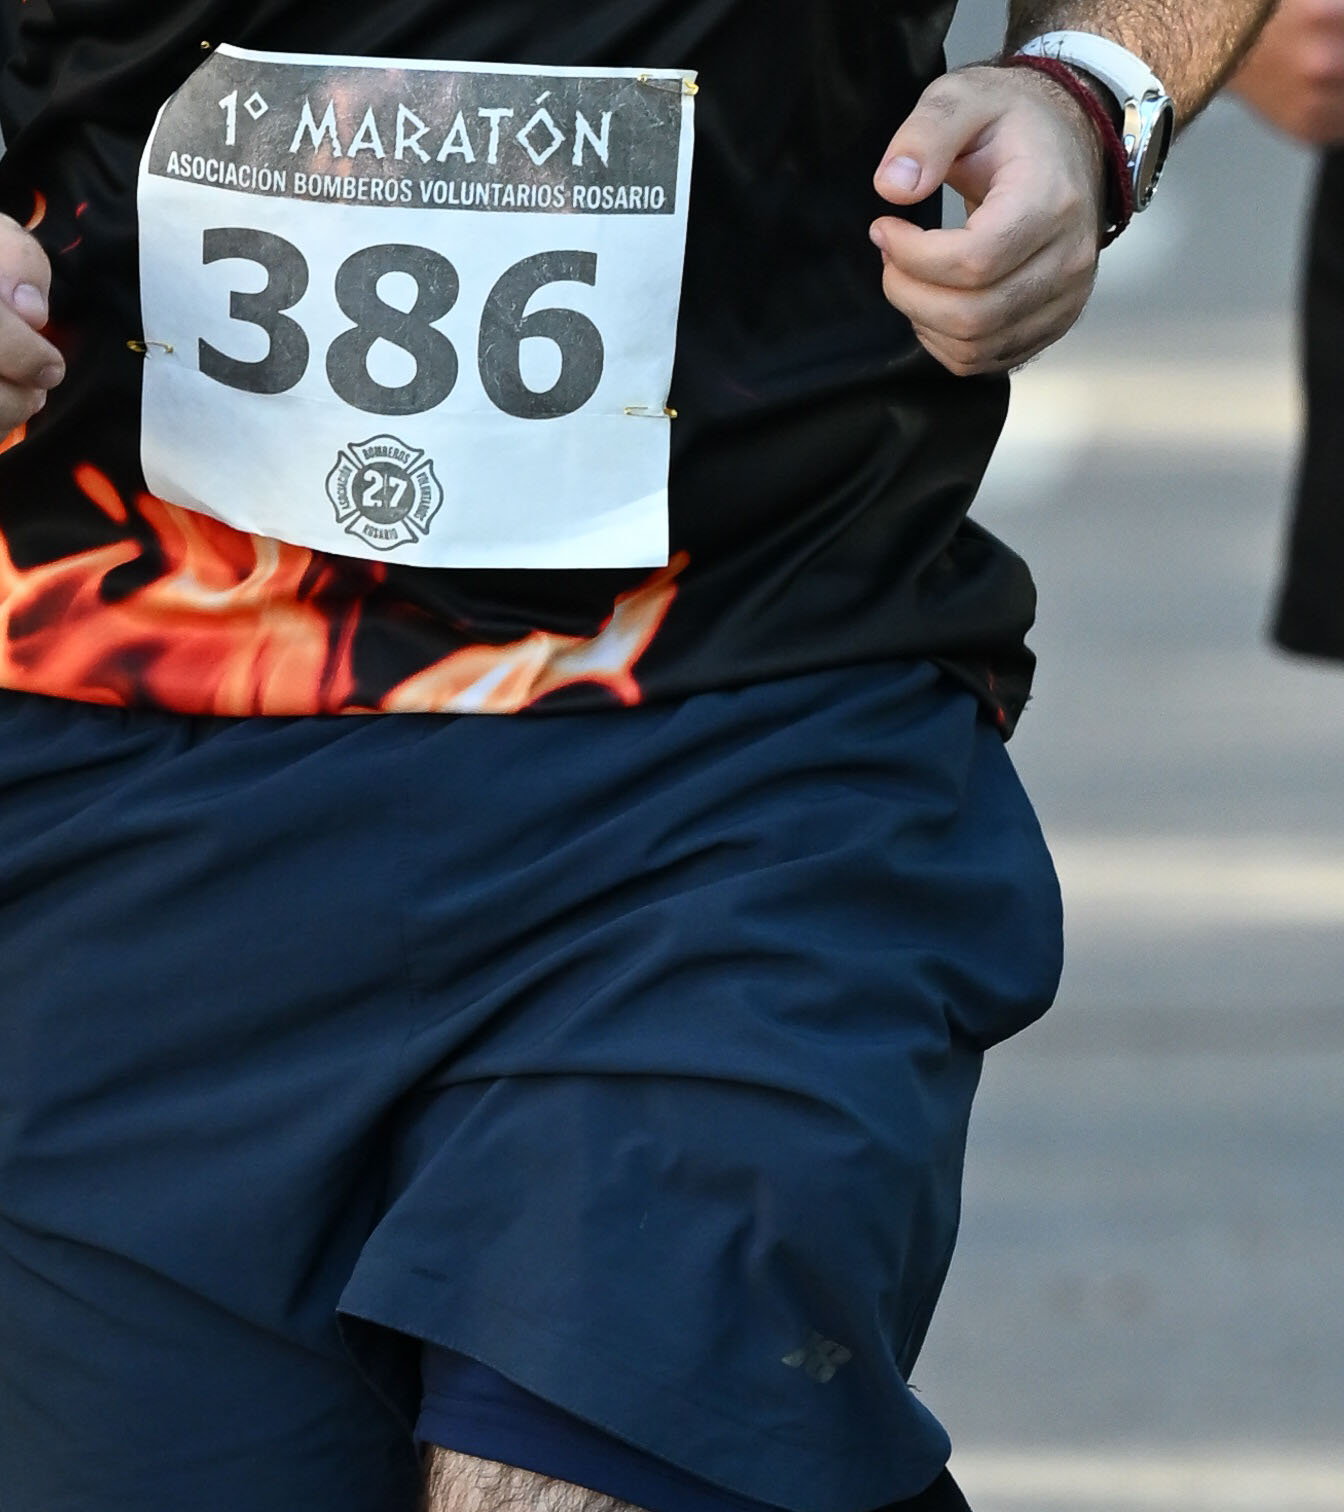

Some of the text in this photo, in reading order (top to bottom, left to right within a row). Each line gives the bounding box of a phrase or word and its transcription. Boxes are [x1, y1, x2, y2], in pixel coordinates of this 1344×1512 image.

[288, 90, 613, 169] MARATÓN
[166, 150, 666, 210] ASOCIACIÓN BOMBEROS VOLUNTARIOS ROSARIO
[198, 226, 605, 420] 386
[361, 469, 408, 508] 27
